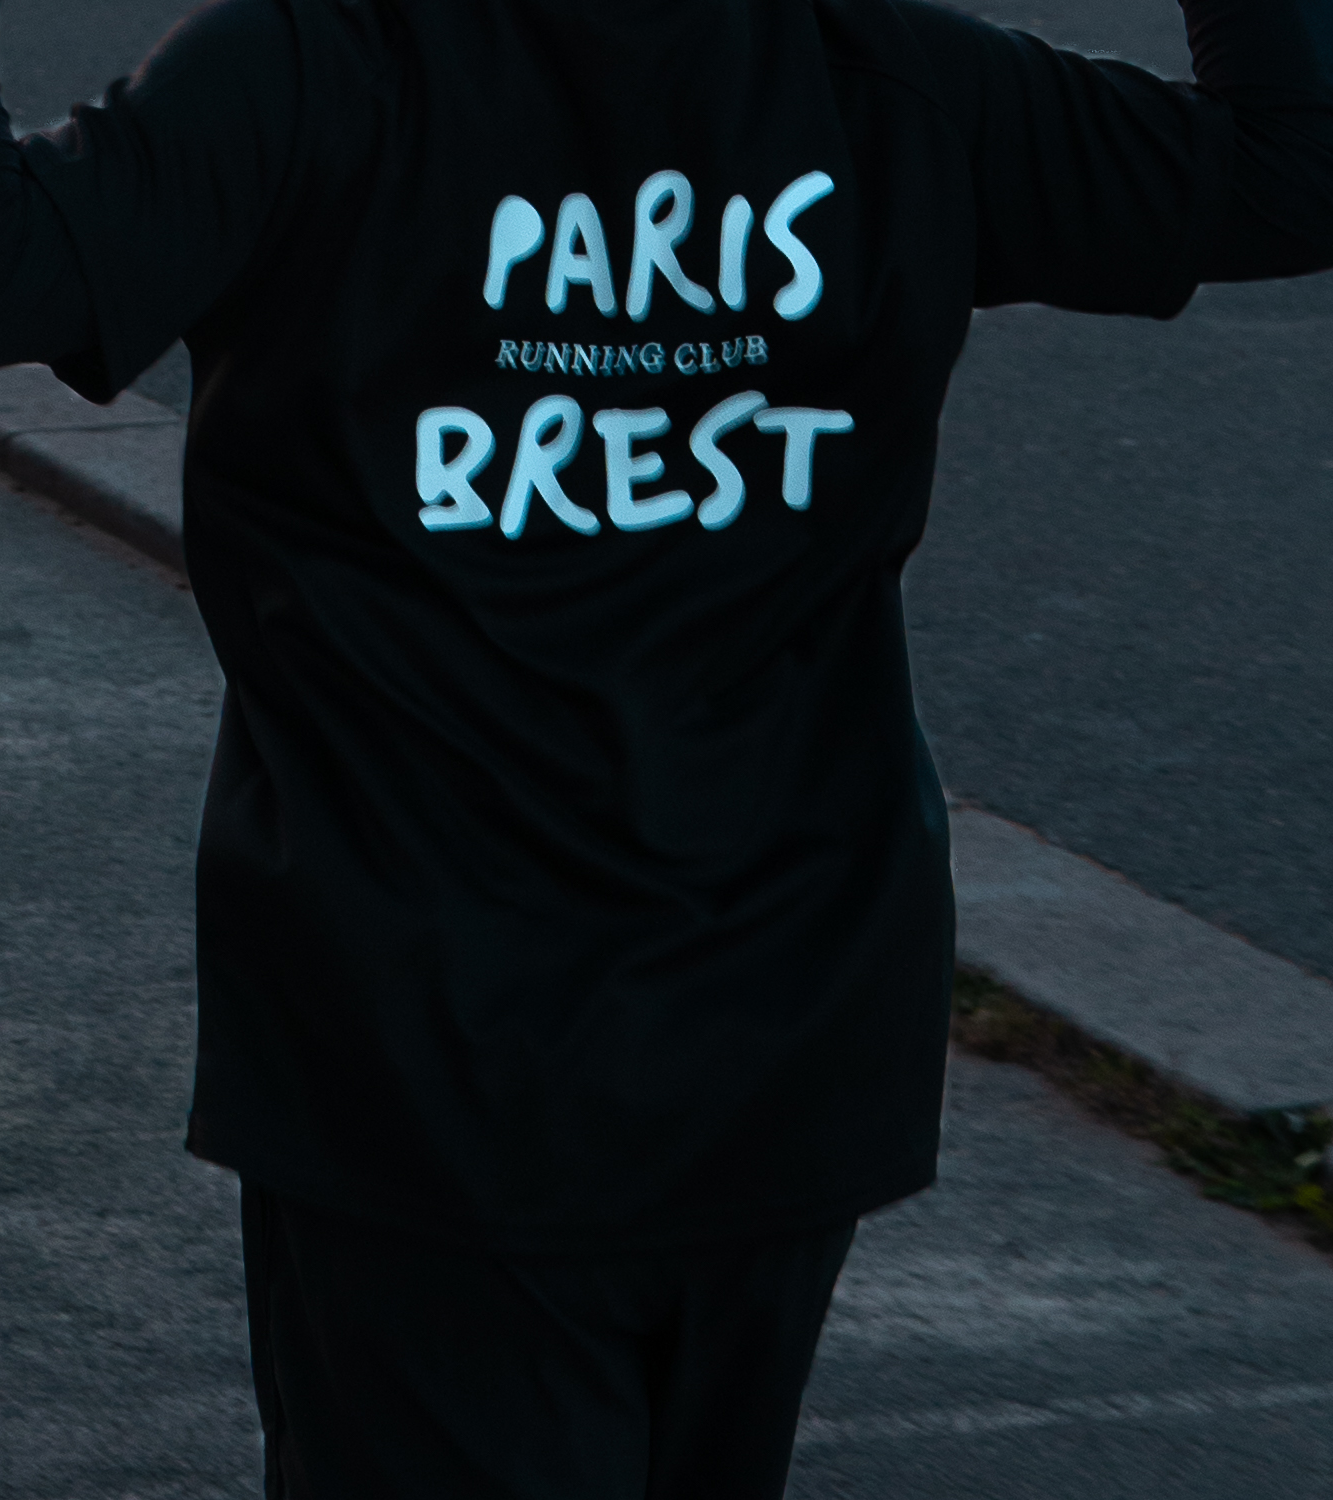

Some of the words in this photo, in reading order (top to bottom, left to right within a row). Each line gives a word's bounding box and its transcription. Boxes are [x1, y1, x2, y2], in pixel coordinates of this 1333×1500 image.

[483, 169, 835, 322] PARIS
[495, 339, 666, 376] RUNNING
[674, 334, 768, 375] CLUB
[415, 390, 855, 540] BREST
